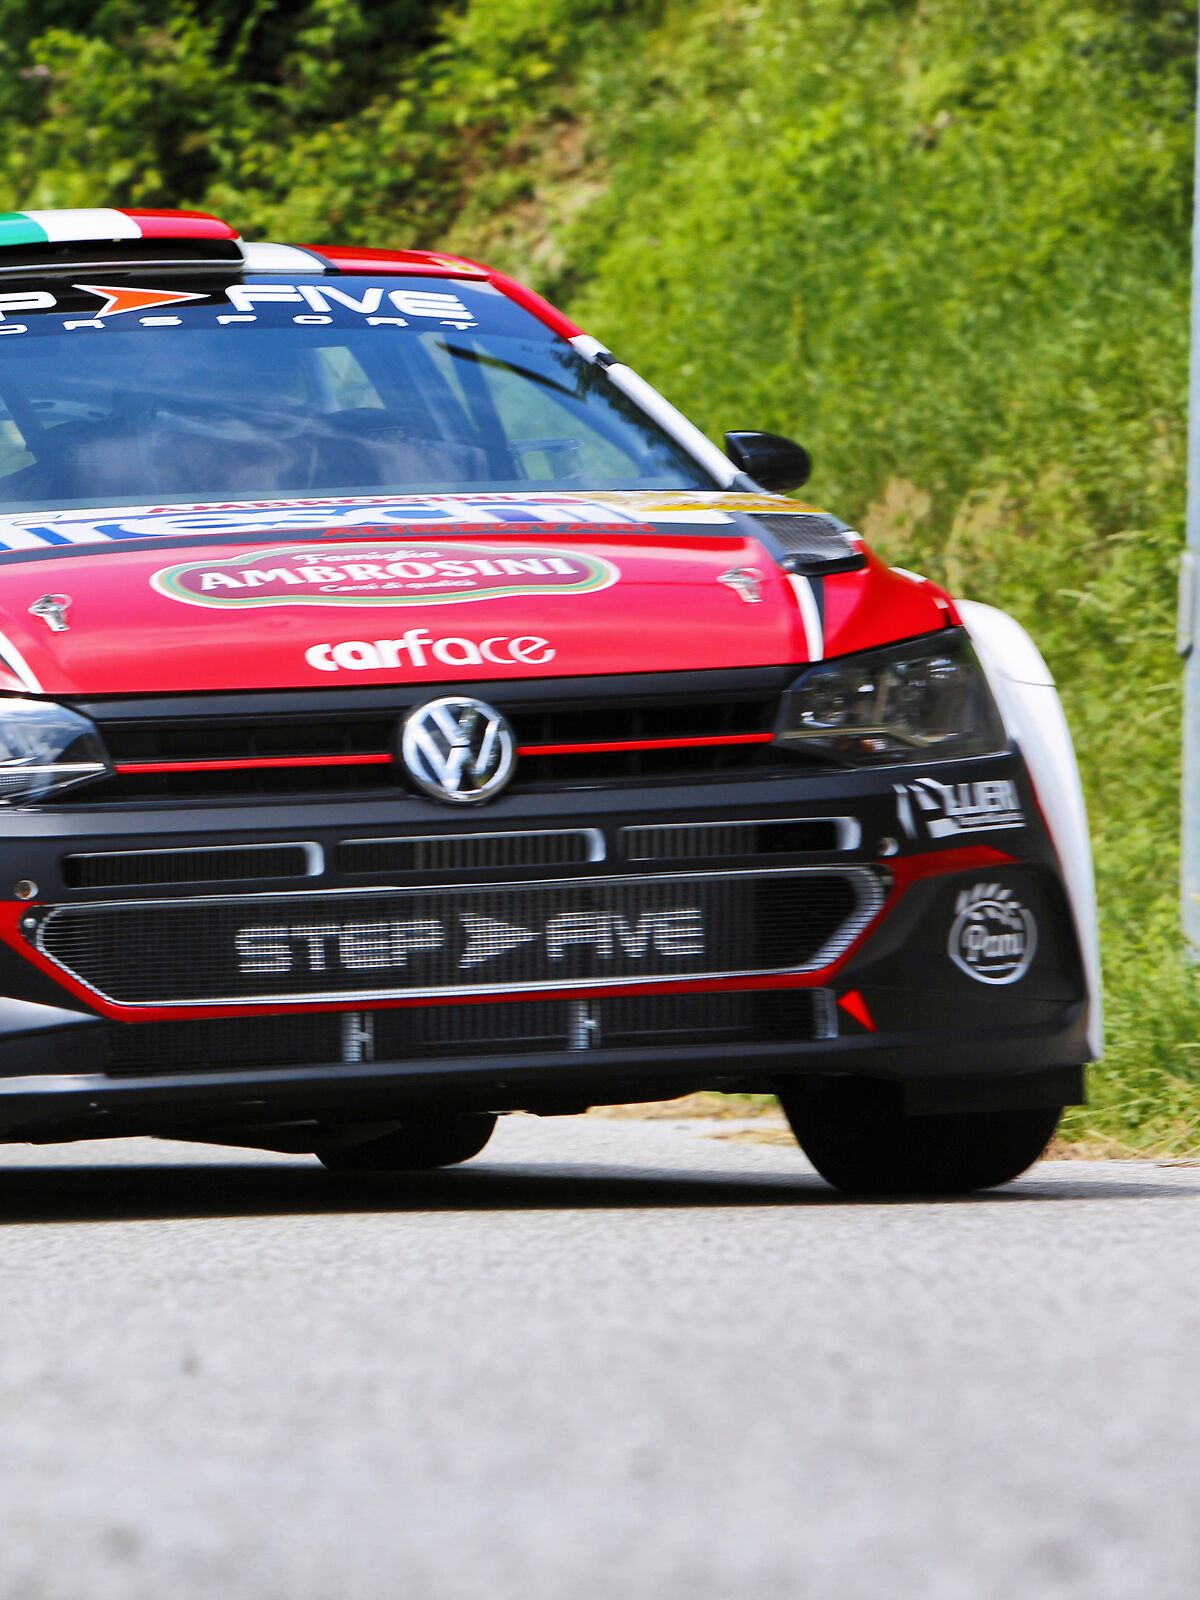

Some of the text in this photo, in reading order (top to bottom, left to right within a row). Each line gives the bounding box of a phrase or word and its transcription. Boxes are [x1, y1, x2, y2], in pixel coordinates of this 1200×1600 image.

[225, 284, 475, 319] FIVE
[147, 495, 516, 513] AMBROSINI
[200, 557, 579, 591] AMBROSINI
[291, 549, 443, 566] Famiglia
[304, 629, 555, 671] carface
[235, 919, 444, 973] STEP
